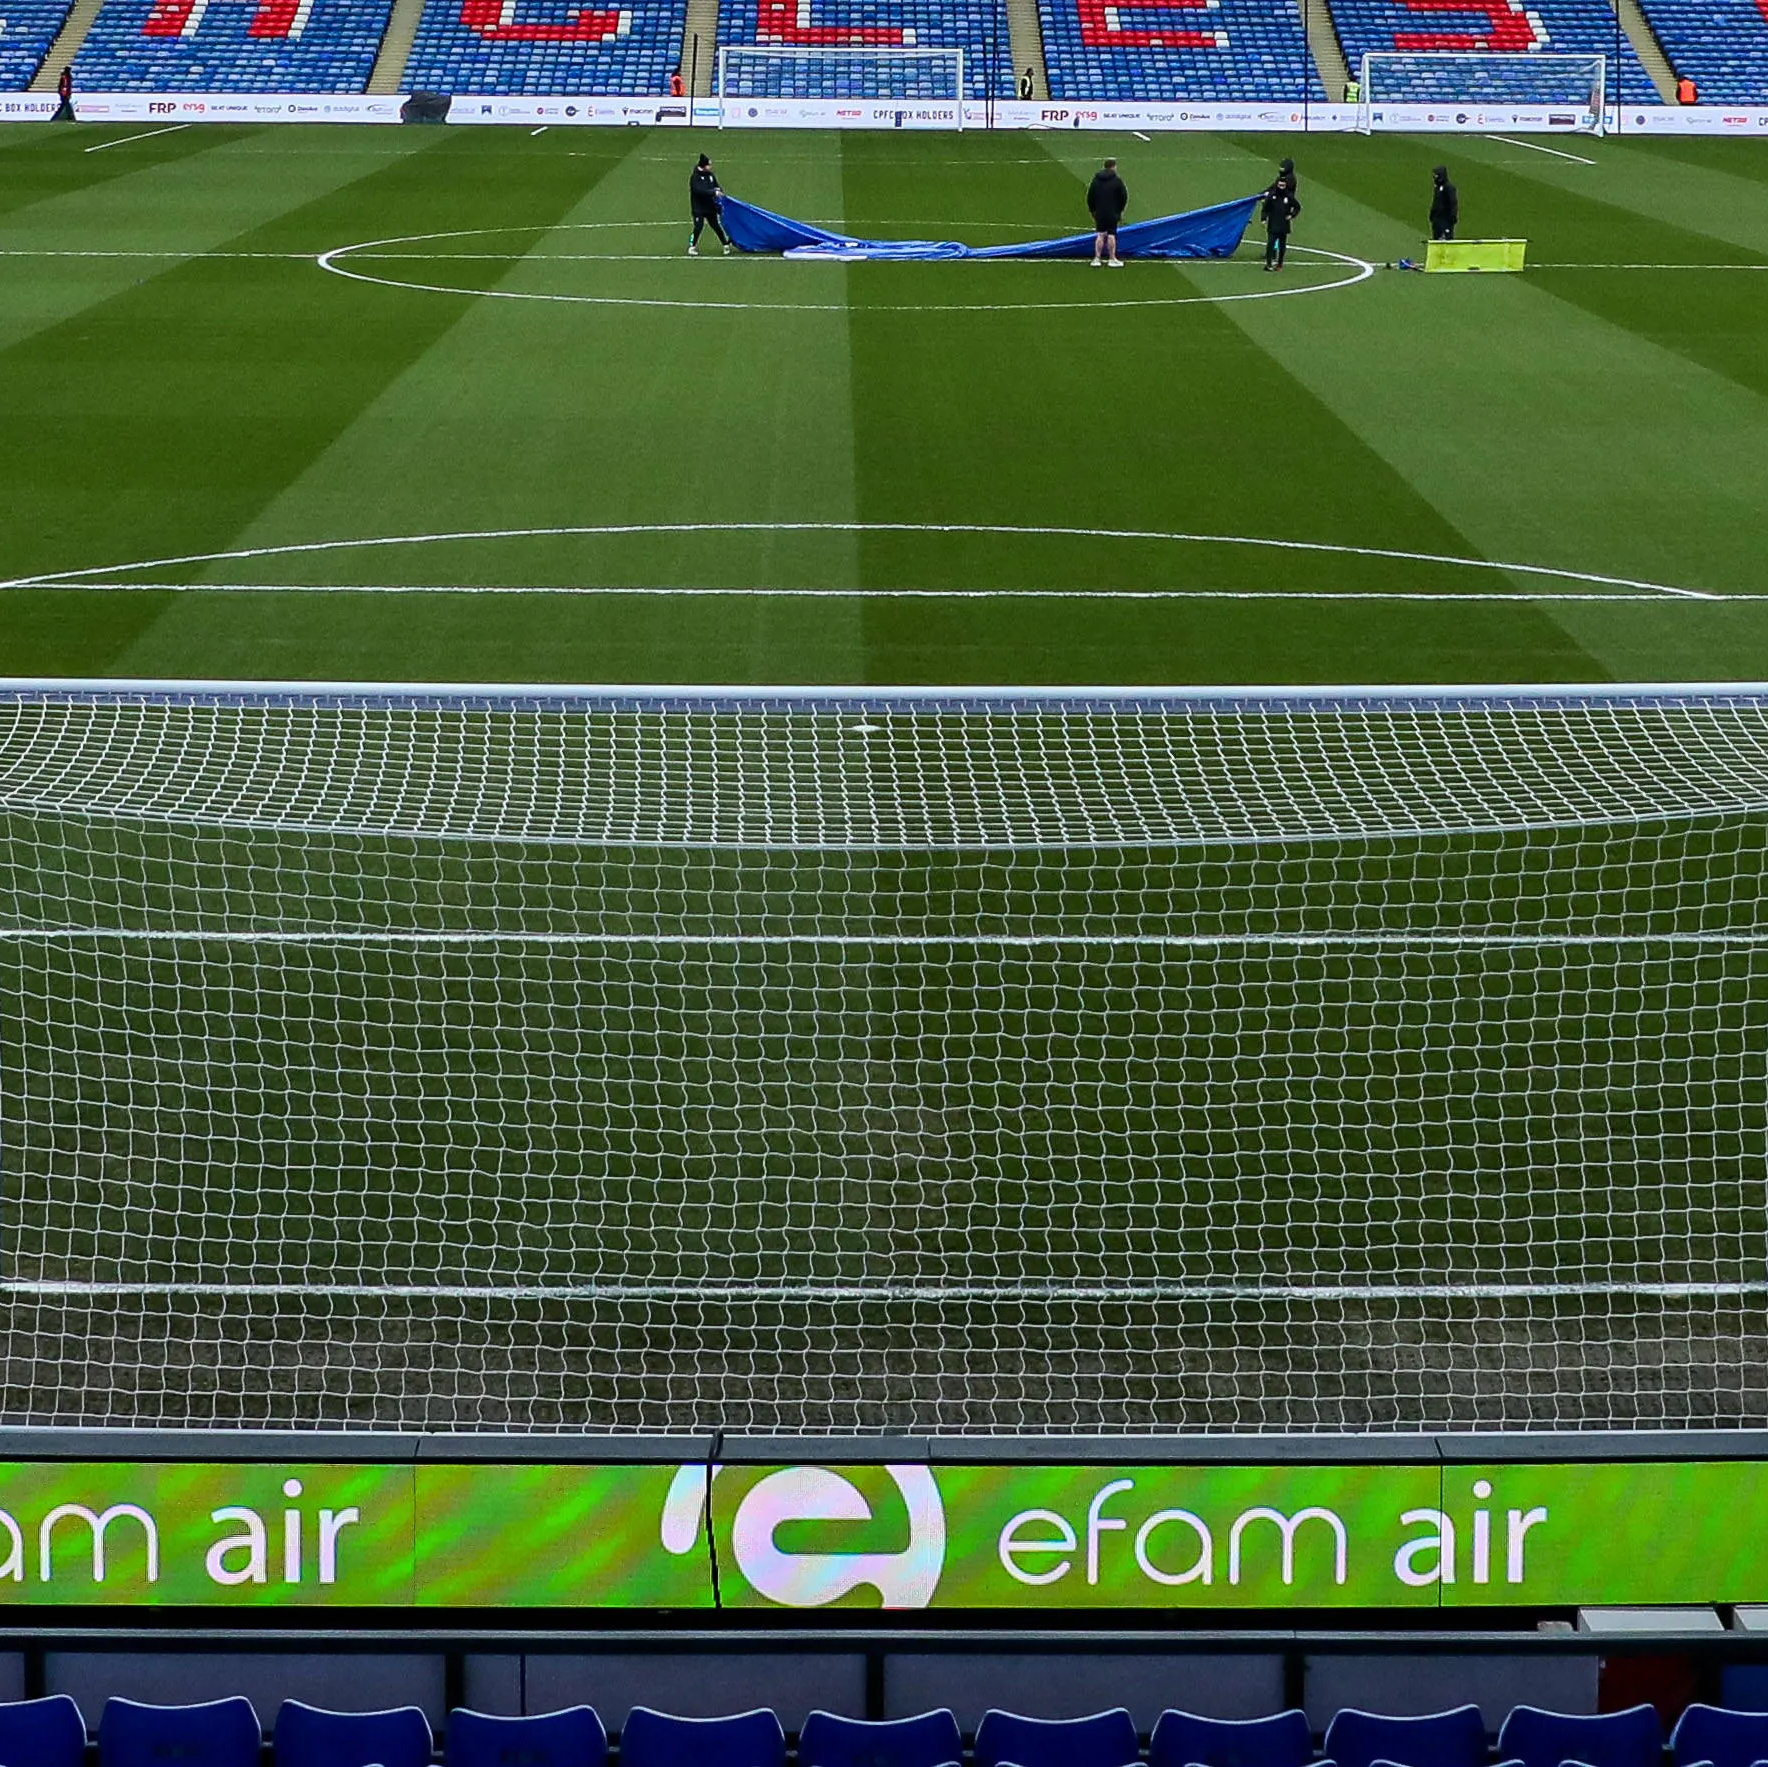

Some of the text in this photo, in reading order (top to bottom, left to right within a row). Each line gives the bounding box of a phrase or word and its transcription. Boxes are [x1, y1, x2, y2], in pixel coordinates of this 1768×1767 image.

[5, 103, 21, 112] BOX
[149, 103, 177, 114] FRP
[873, 110, 894, 120] CPFC
[916, 111, 954, 120] HOLDERS
[1041, 110, 1069, 121] FRP
[205, 1479, 359, 1585] air
[998, 1480, 1547, 1585] efam air
